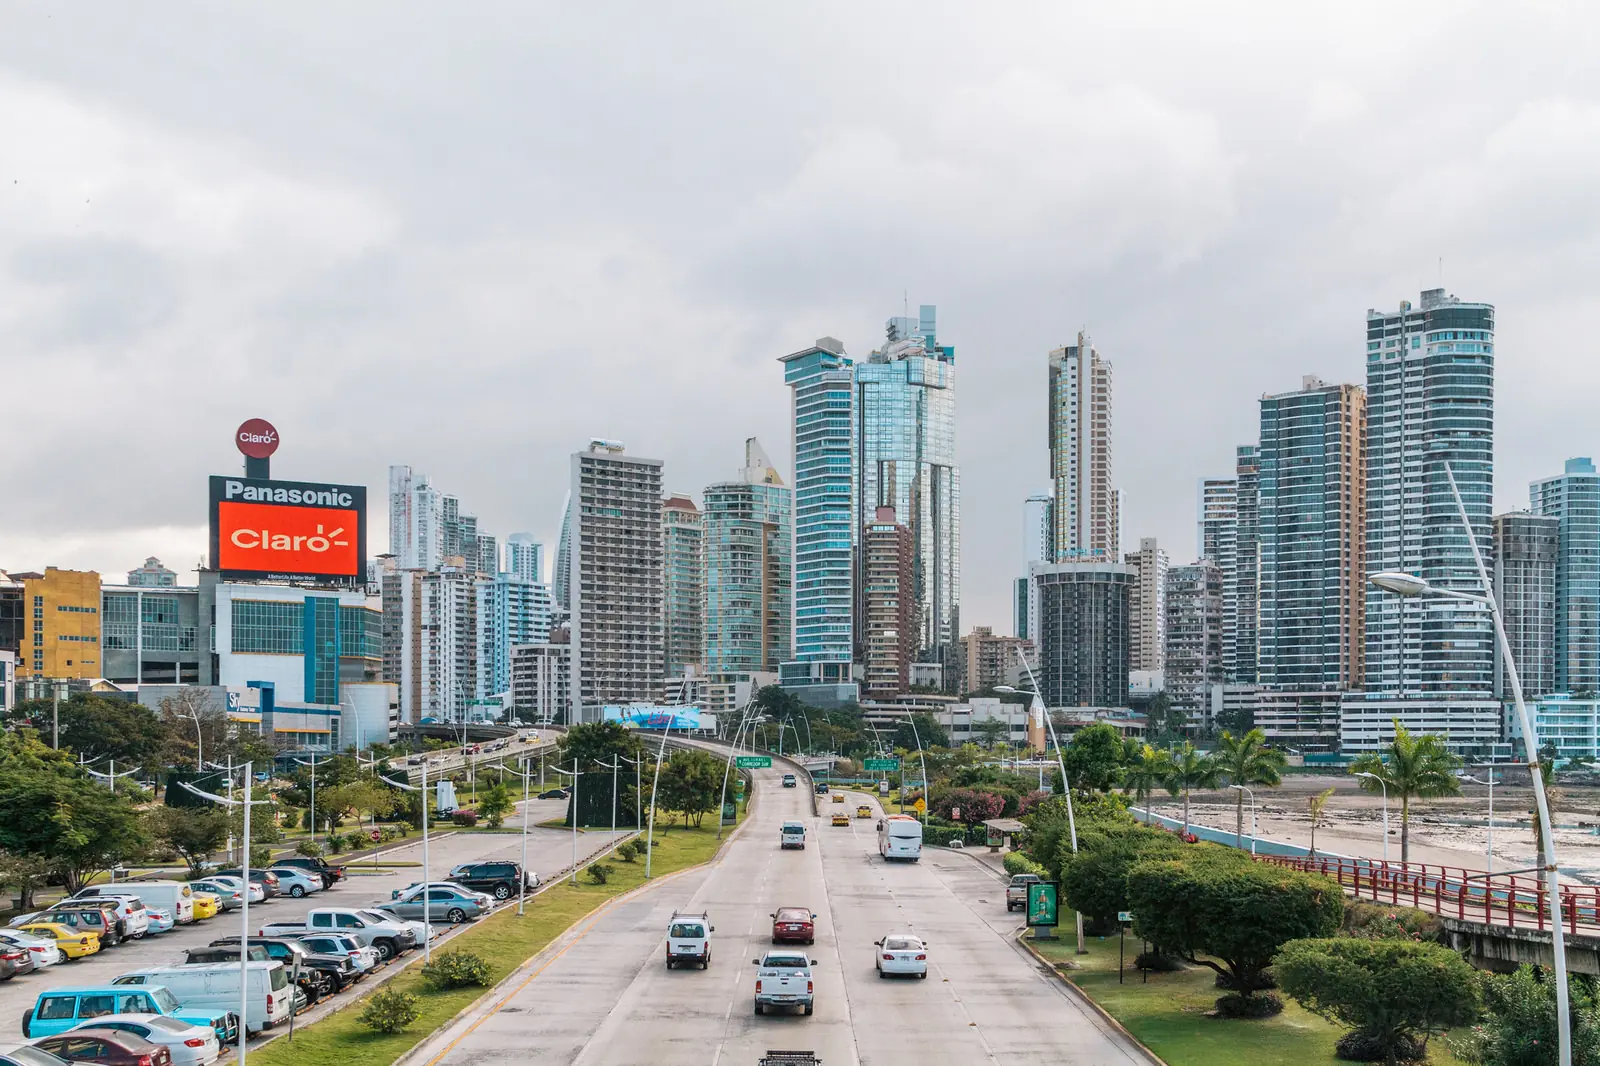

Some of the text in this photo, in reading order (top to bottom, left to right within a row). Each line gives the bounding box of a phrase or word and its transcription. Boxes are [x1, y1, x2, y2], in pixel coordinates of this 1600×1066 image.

[239, 431, 274, 444] Claro
[225, 480, 353, 507] Panasonic
[231, 526, 336, 552] Claro
